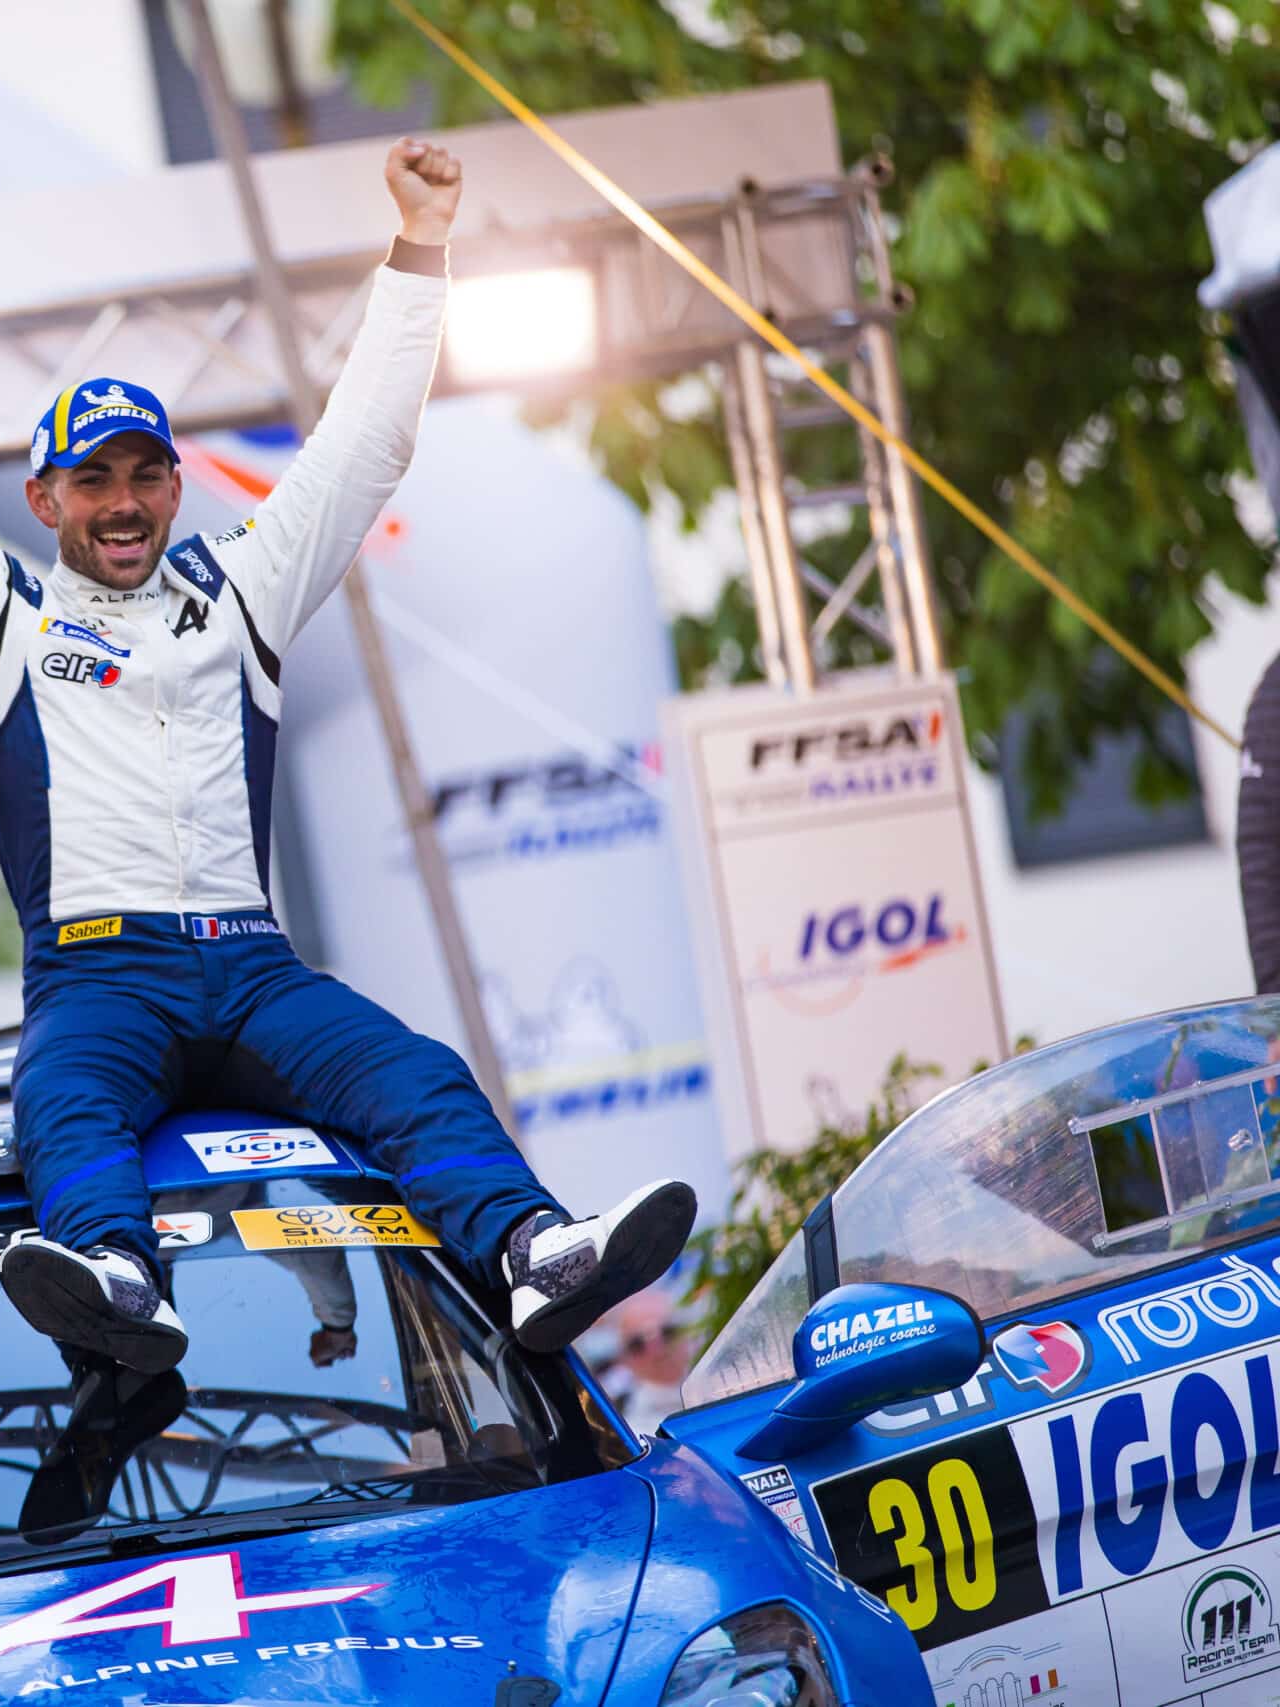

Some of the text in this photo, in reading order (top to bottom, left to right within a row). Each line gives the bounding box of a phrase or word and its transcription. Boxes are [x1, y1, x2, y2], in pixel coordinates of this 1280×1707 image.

[73, 408, 159, 432] MICHELIN
[41, 653, 96, 683] elf
[65, 919, 116, 940] Sabelt
[800, 892, 949, 962] IGOL
[204, 1140, 317, 1156] FUCHS
[282, 1225, 410, 1236] SIVAM
[810, 1301, 933, 1352] CHAZEL
[815, 1323, 937, 1368] technologie course
[1047, 1355, 1280, 1597] IGOL
[869, 1458, 998, 1631] 30
[1201, 1594, 1253, 1651] 111
[19, 1650, 239, 1697] ALPINE
[256, 1635, 483, 1662] FREJUS
